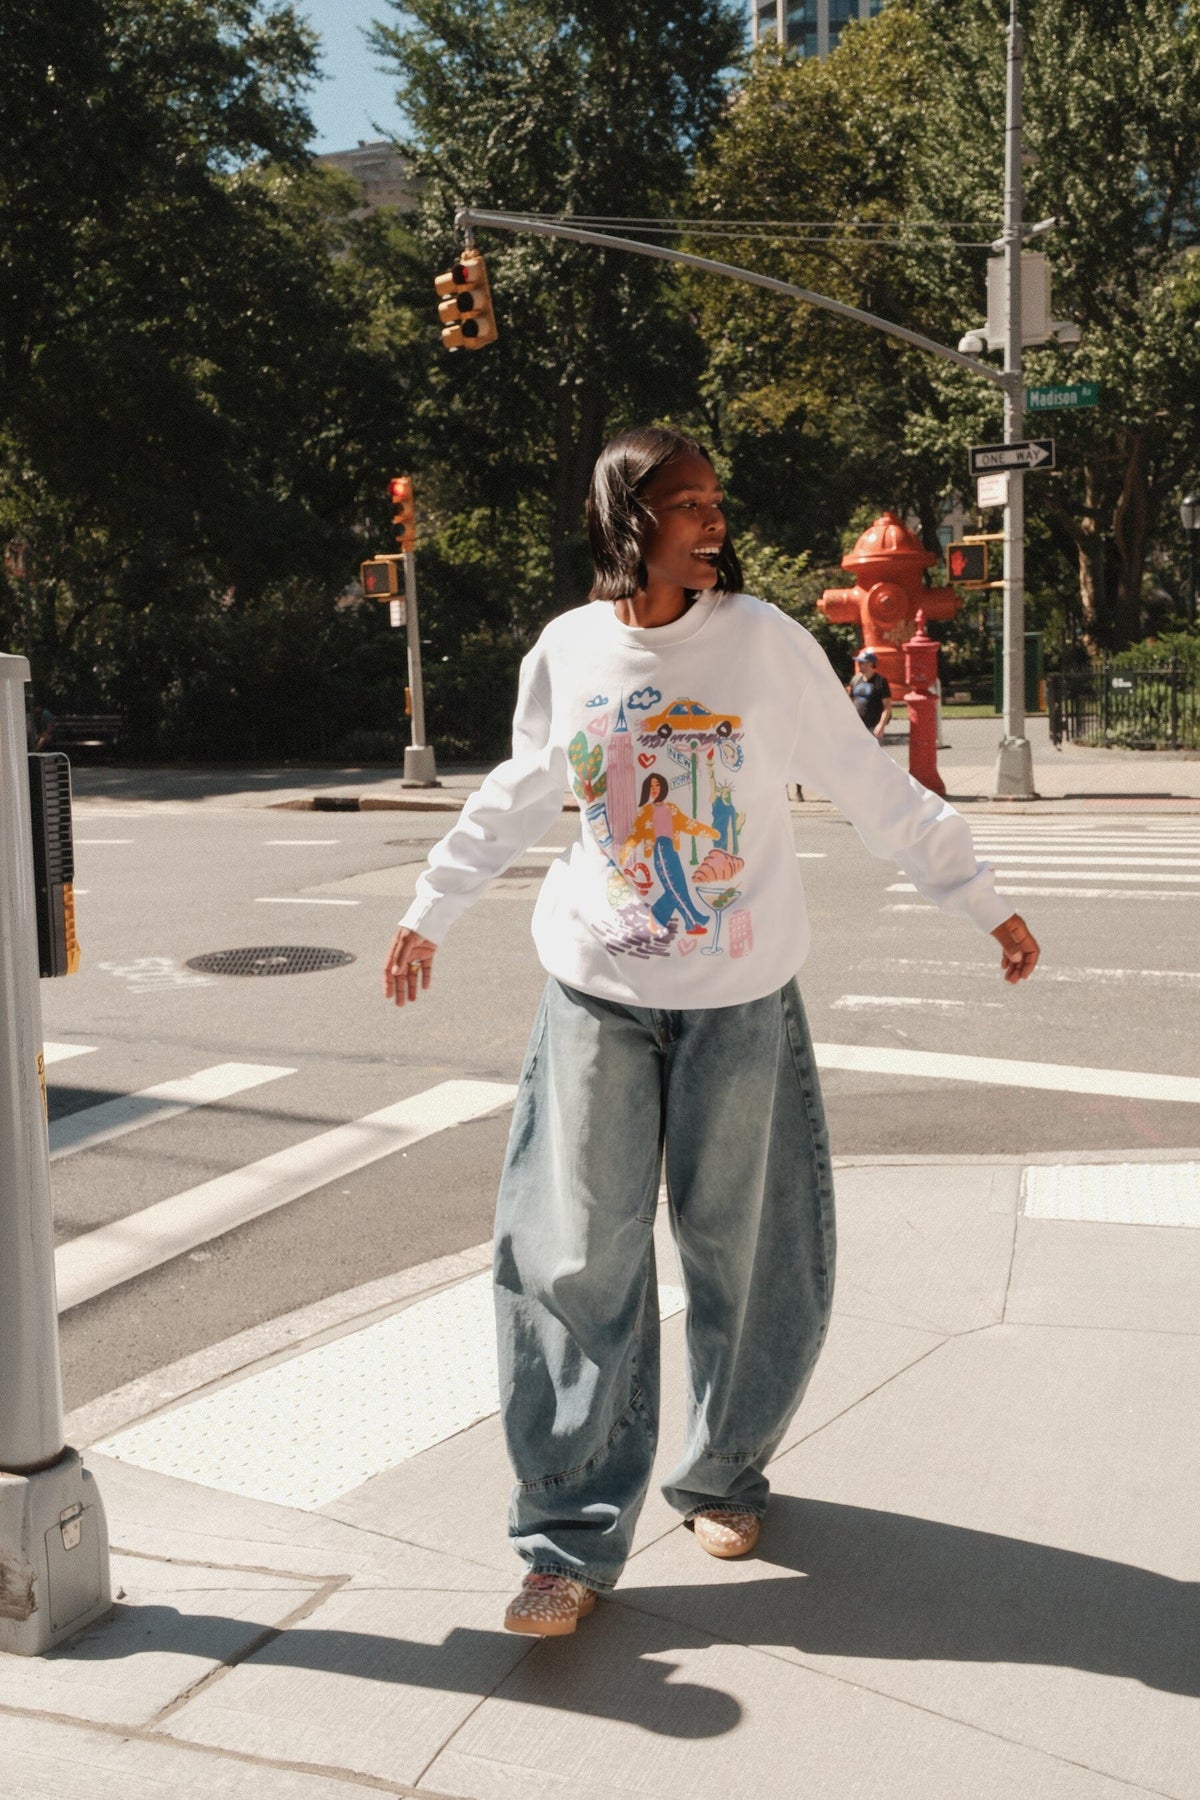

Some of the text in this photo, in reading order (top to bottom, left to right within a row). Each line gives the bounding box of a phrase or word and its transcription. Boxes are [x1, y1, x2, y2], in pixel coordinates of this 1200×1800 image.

[1030, 391, 1077, 407] Madison
[982, 450, 1040, 465] ONE WAY
[669, 748, 691, 769] NEW
[671, 774, 692, 786] YORK
